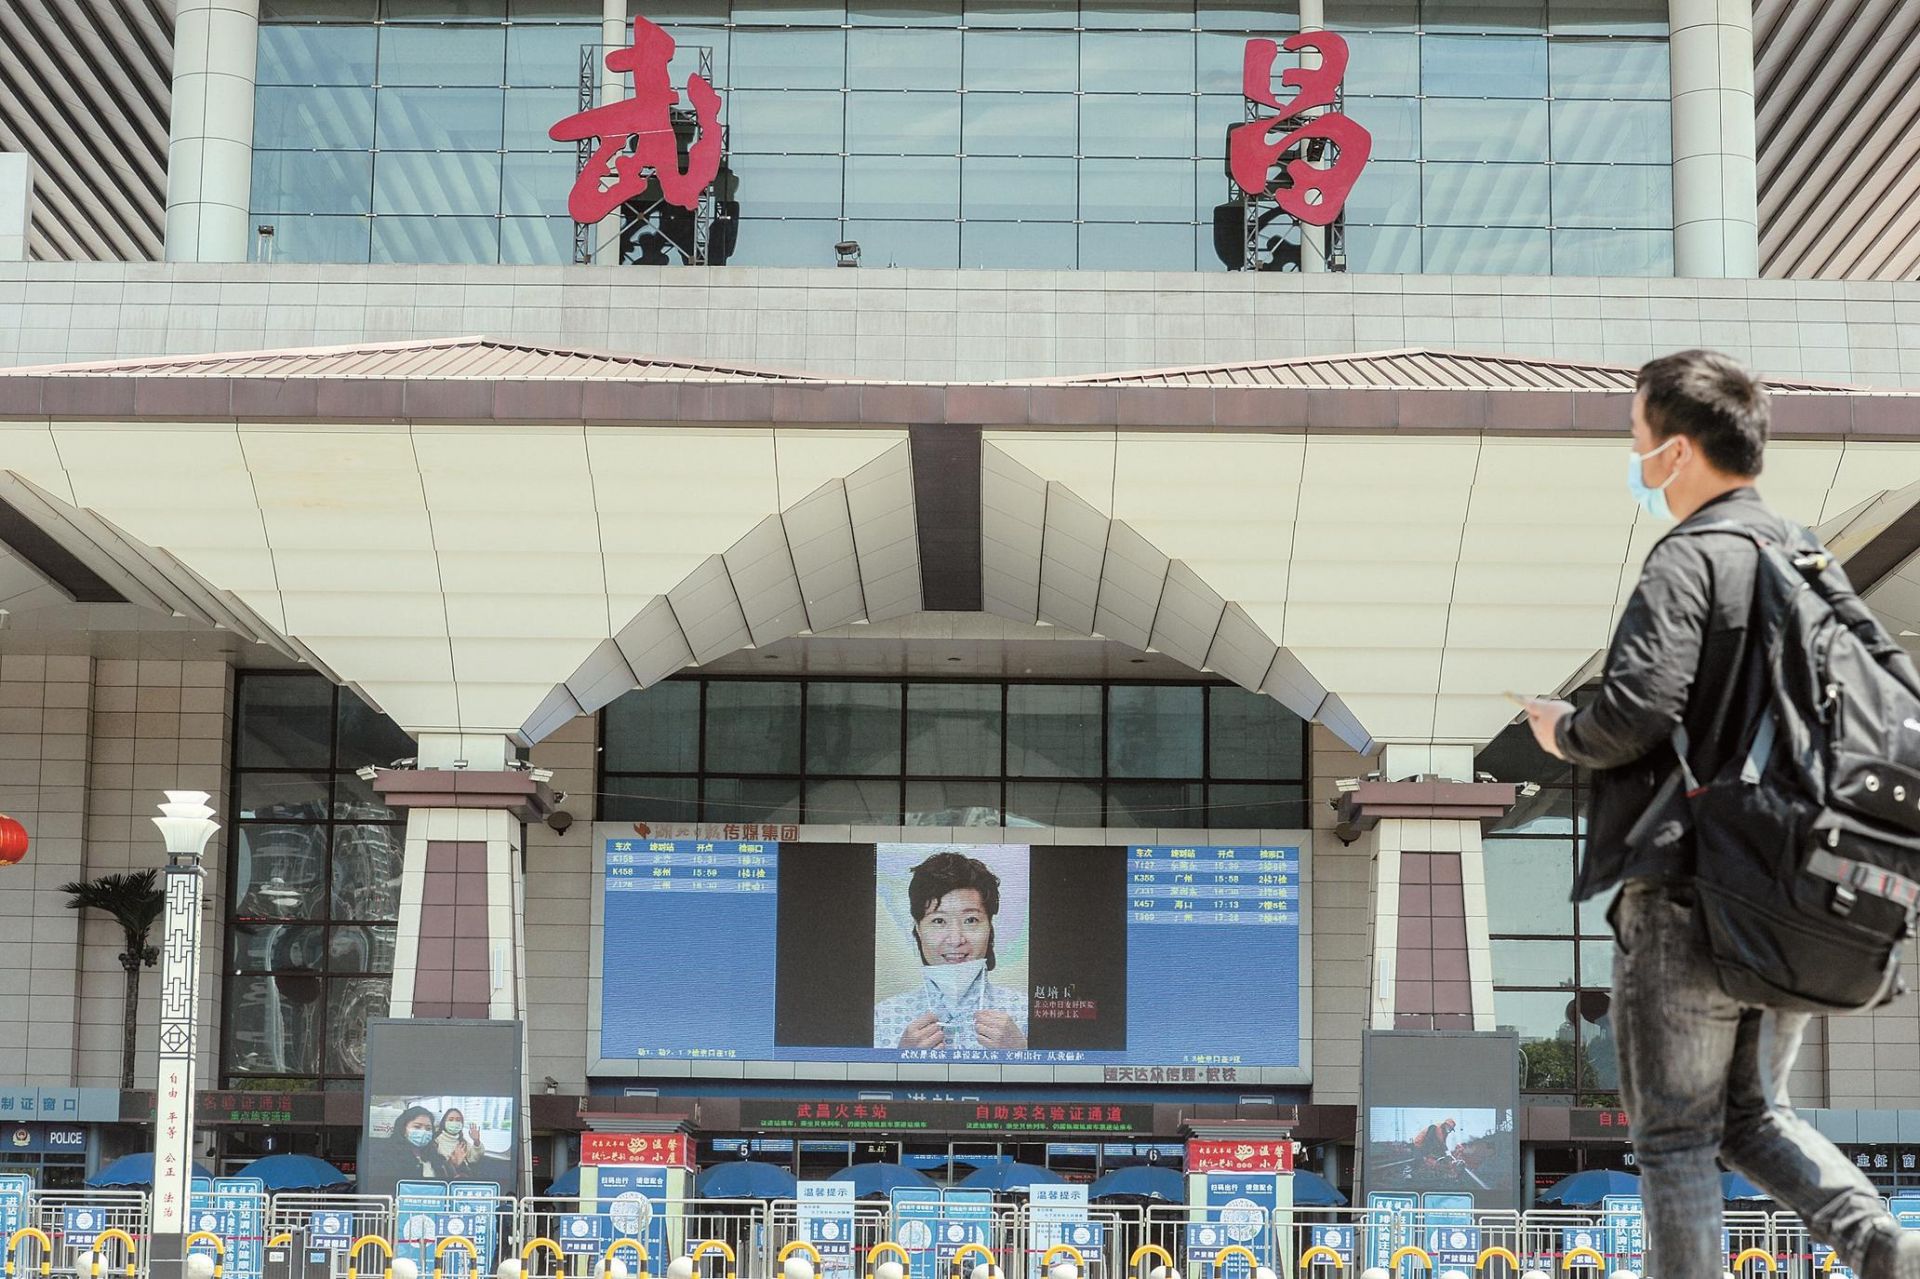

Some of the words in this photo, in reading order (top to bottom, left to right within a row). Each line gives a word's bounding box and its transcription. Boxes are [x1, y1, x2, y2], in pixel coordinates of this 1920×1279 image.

[1, 1097, 76, 1111] 制证窗口
[796, 1103, 888, 1119] 武昌火车站
[976, 1104, 1122, 1122] 自助实名验证通道
[50, 1132, 82, 1144] POLICE
[652, 1138, 679, 1151] 温馨
[740, 1145, 749, 1157] 5
[1149, 1148, 1158, 1162] 6
[1259, 1145, 1285, 1158] 温馨
[1623, 1153, 1635, 1165] 10
[1857, 1154, 1916, 1168] 主任窗
[803, 1188, 848, 1197] 温馨提示
[1037, 1190, 1081, 1200] 温馨提示
